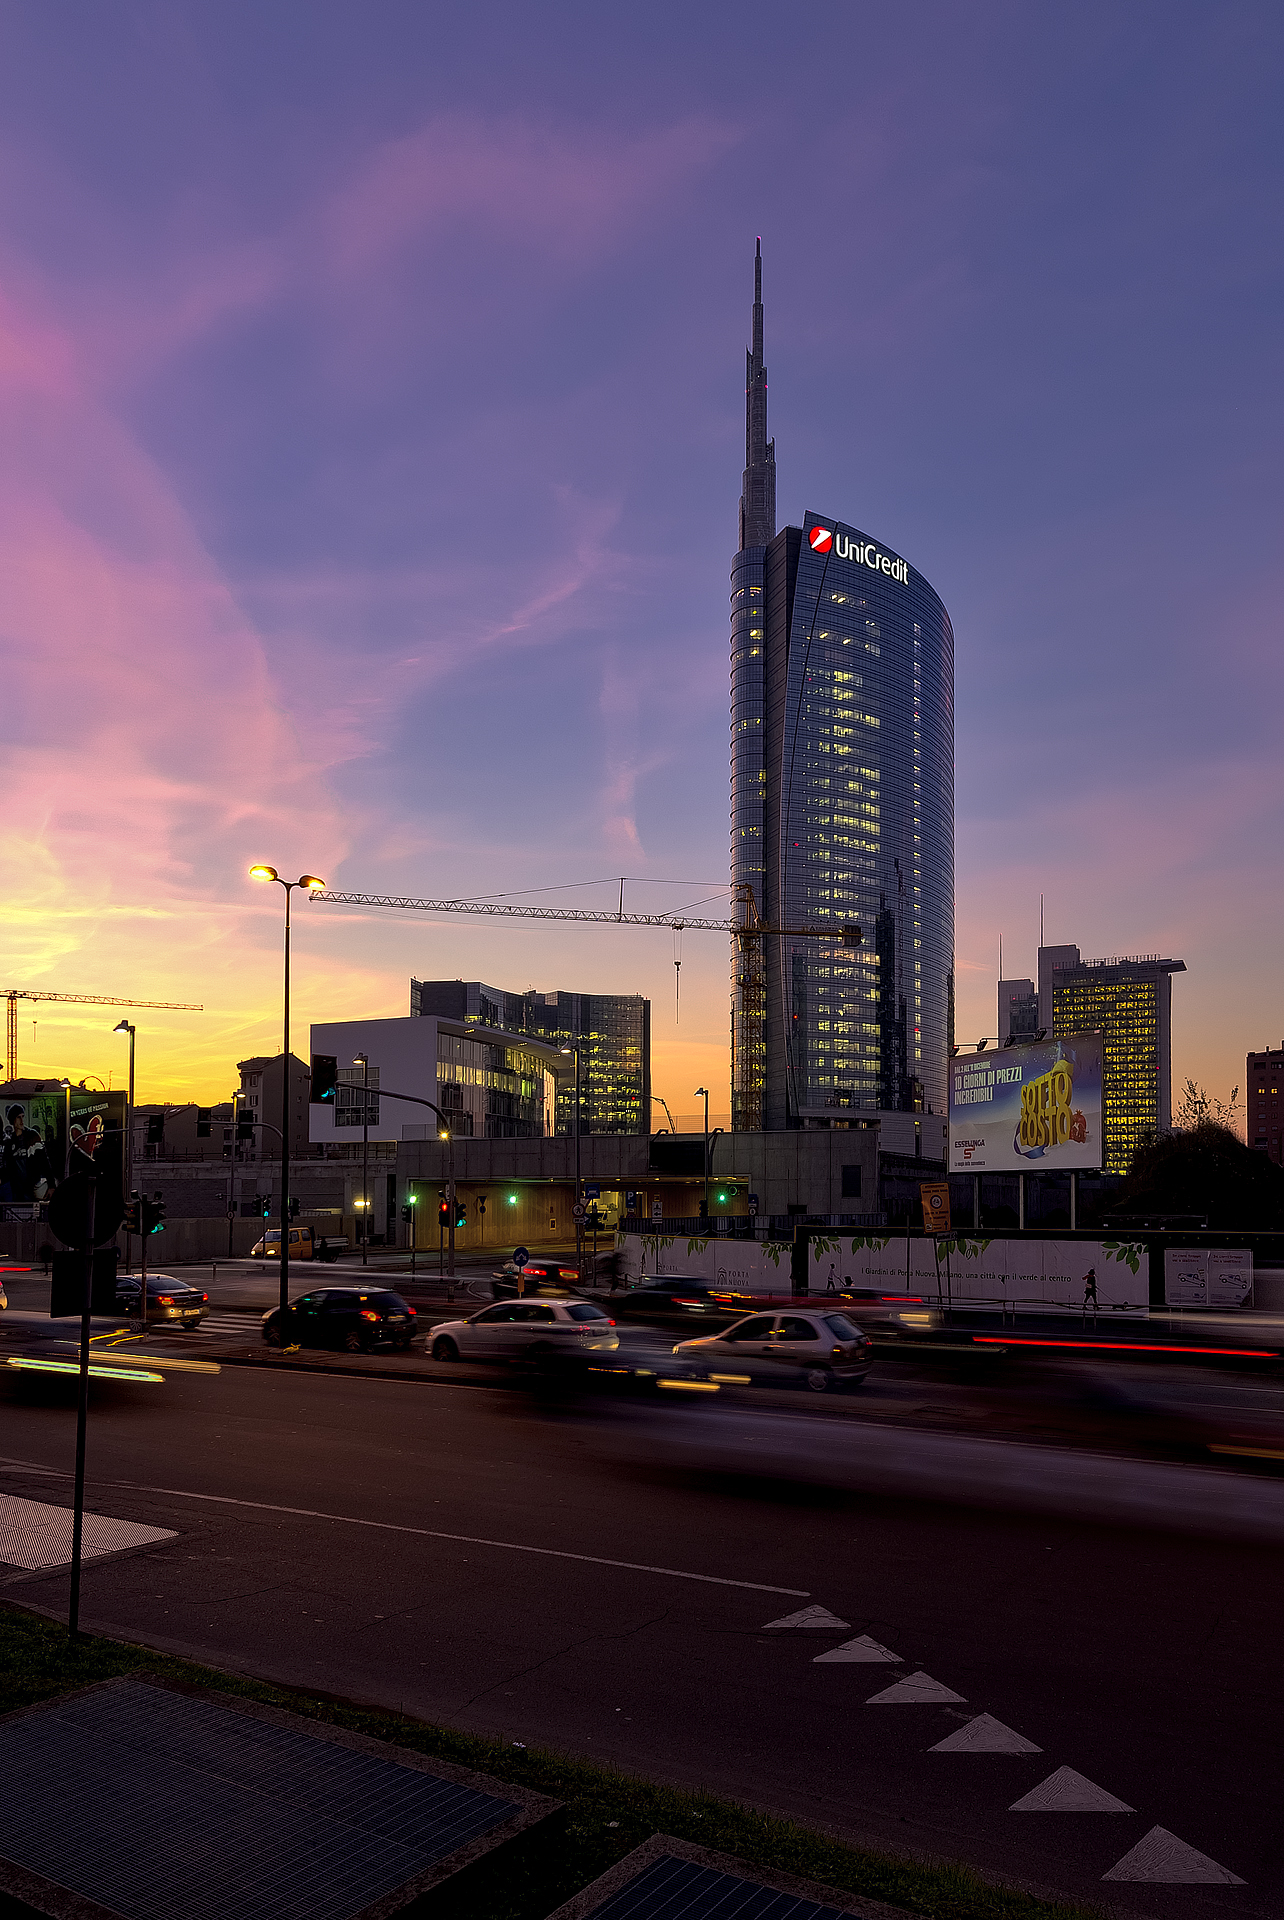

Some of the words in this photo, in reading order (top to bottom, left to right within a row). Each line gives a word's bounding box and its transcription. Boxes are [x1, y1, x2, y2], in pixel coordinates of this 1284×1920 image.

[835, 533, 909, 586] UniCredit
[954, 1076, 963, 1090] 10
[963, 1072, 987, 1089] GIORNI
[987, 1070, 995, 1086] DI
[996, 1065, 1022, 1084] PREZZI
[954, 1086, 993, 1106] INCREDIBILI
[1020, 1067, 1073, 1112] SOTTO
[1020, 1106, 1073, 1147] COSTO
[627, 1191, 635, 1201] P
[728, 1279, 749, 1287] NUOVA
[865, 1267, 889, 1275] Giardini
[980, 1271, 996, 1280] città
[1012, 1272, 1017, 1280] il
[1018, 1272, 1038, 1281] verde
[1040, 1273, 1047, 1281] al
[1048, 1274, 1072, 1283] centro
